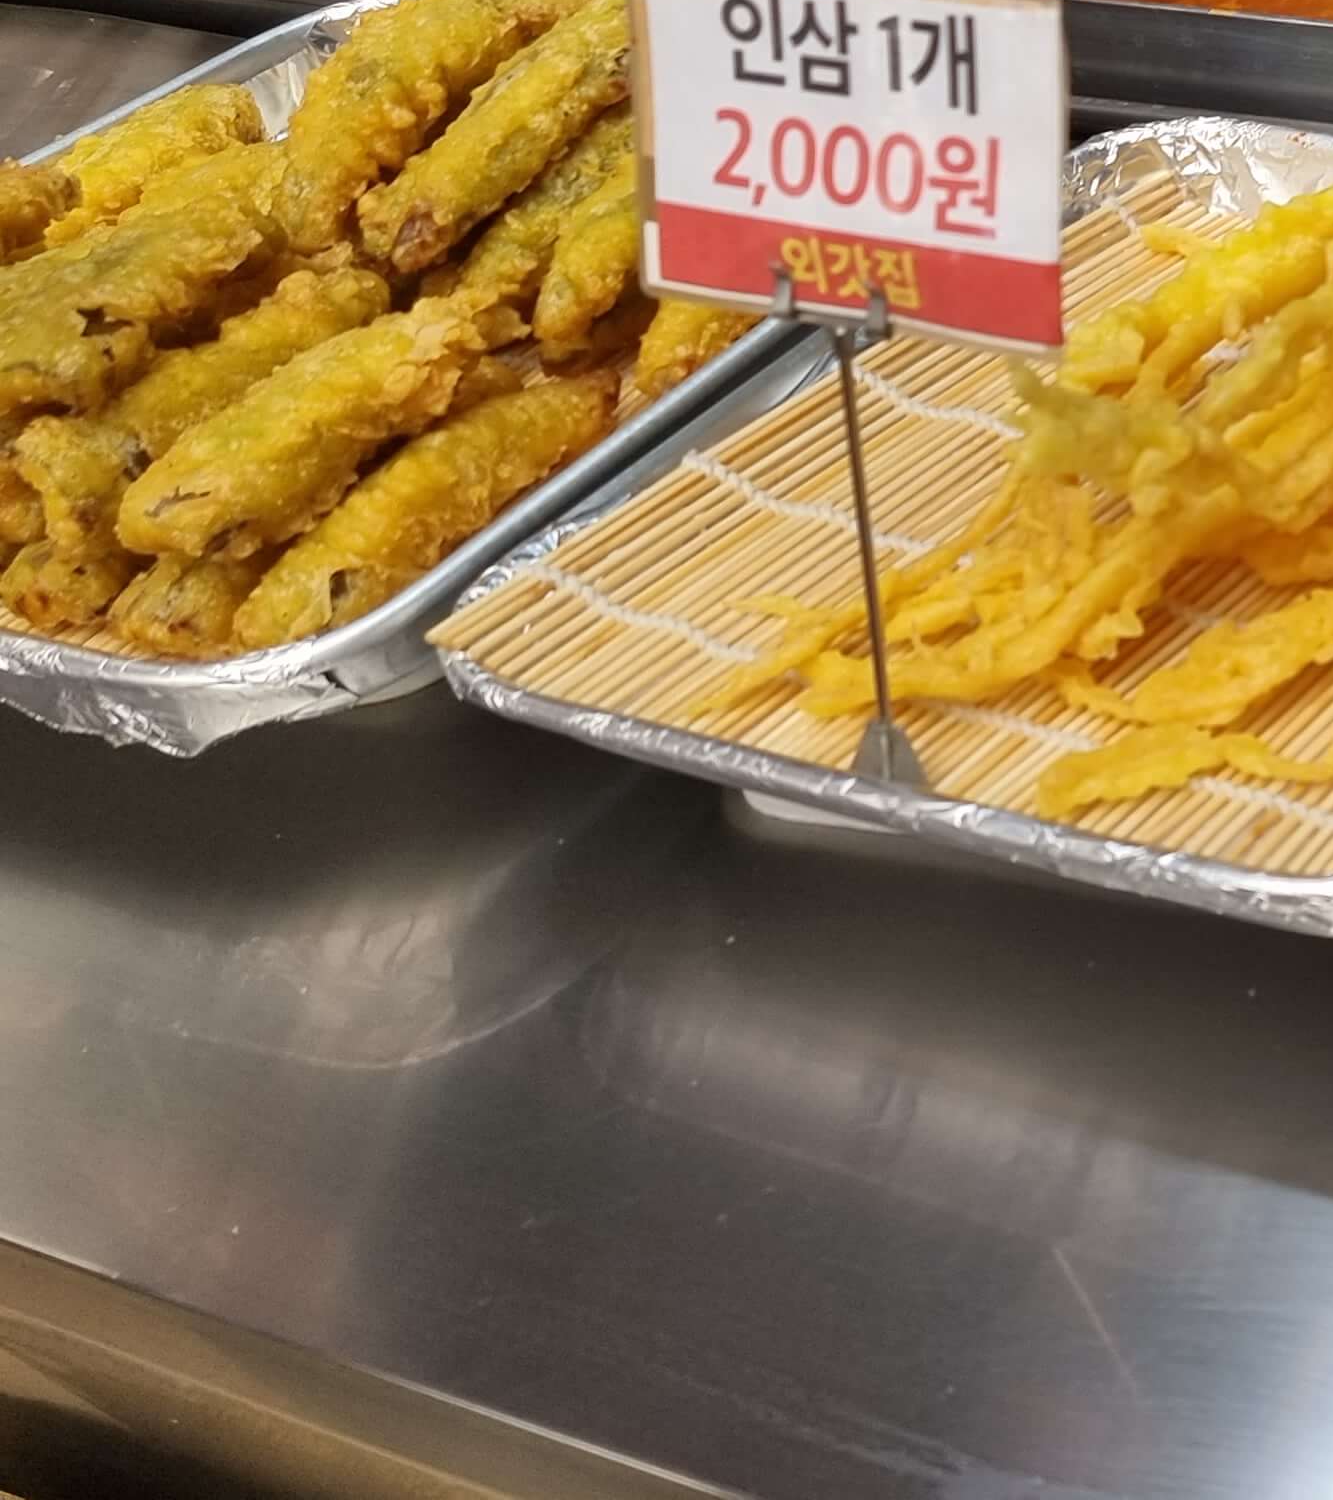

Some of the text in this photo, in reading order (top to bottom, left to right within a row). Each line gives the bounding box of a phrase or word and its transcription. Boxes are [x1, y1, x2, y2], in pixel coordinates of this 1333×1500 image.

[875, 13, 980, 117] 1개
[711, 107, 1001, 241] 2,000원
[779, 236, 922, 311] 외갓집
